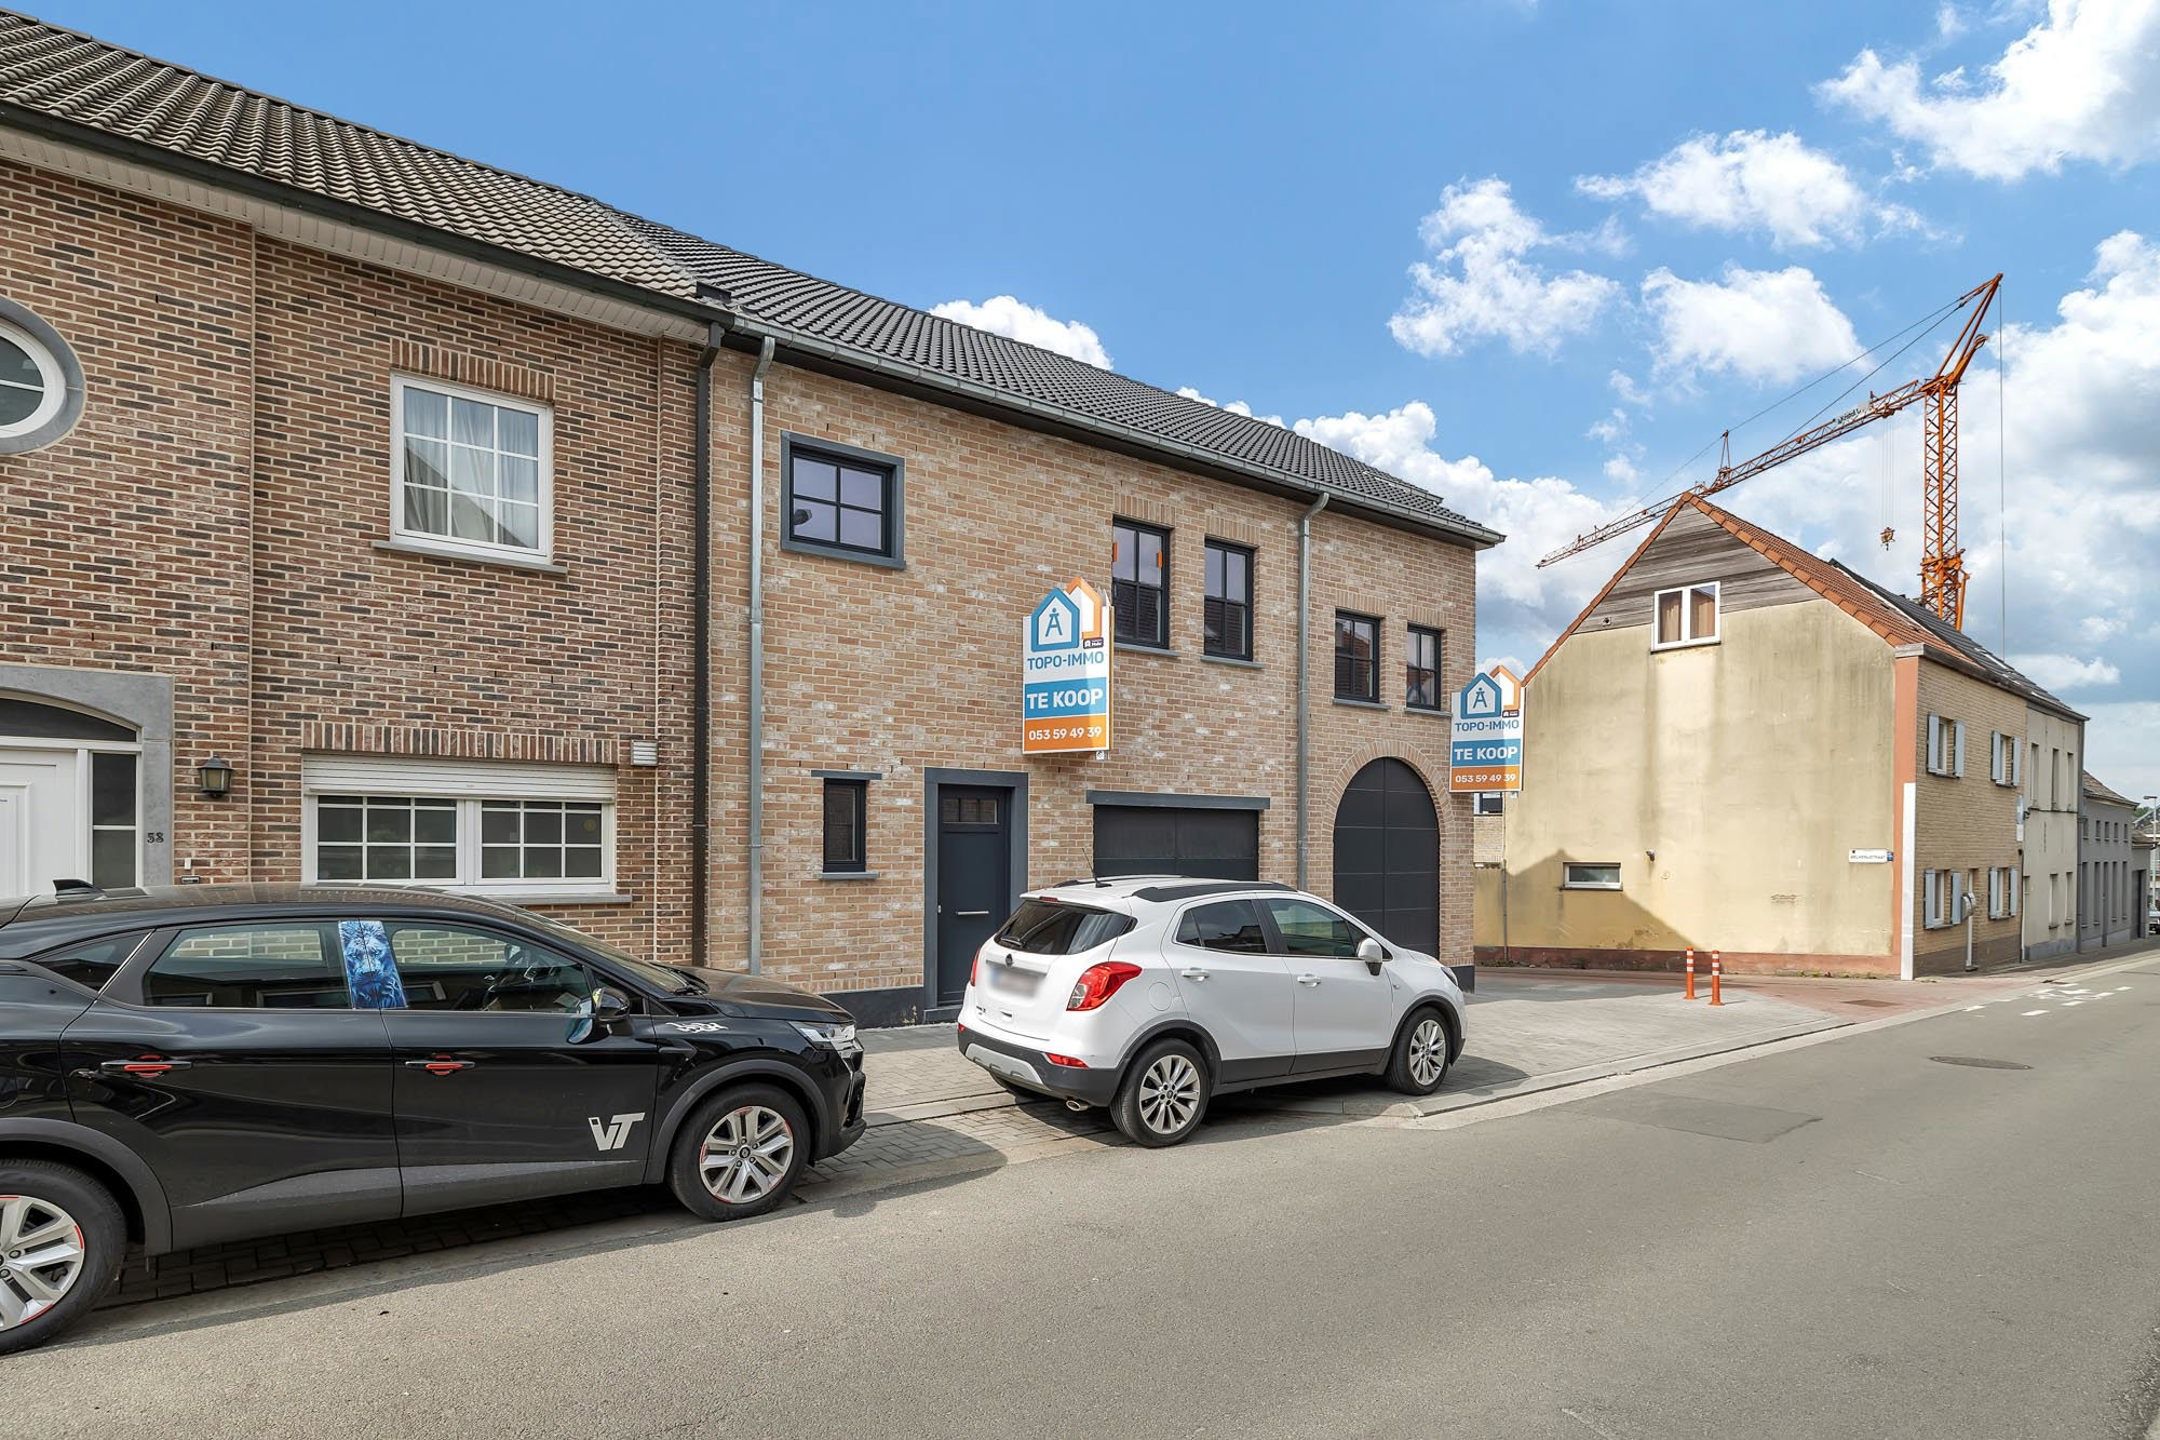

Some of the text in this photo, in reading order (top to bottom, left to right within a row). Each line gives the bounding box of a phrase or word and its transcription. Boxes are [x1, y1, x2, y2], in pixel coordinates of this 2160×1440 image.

[1027, 651, 1104, 670] TOPO-IMMO
[1026, 688, 1104, 709] TE KOOP
[1455, 719, 1520, 732] TOPO-IMMO
[1028, 726, 1102, 740] 053 59 49 39
[1454, 746, 1518, 760] TE KOOP
[1455, 773, 1516, 783] 053 59 49 39
[147, 831, 165, 844] 58
